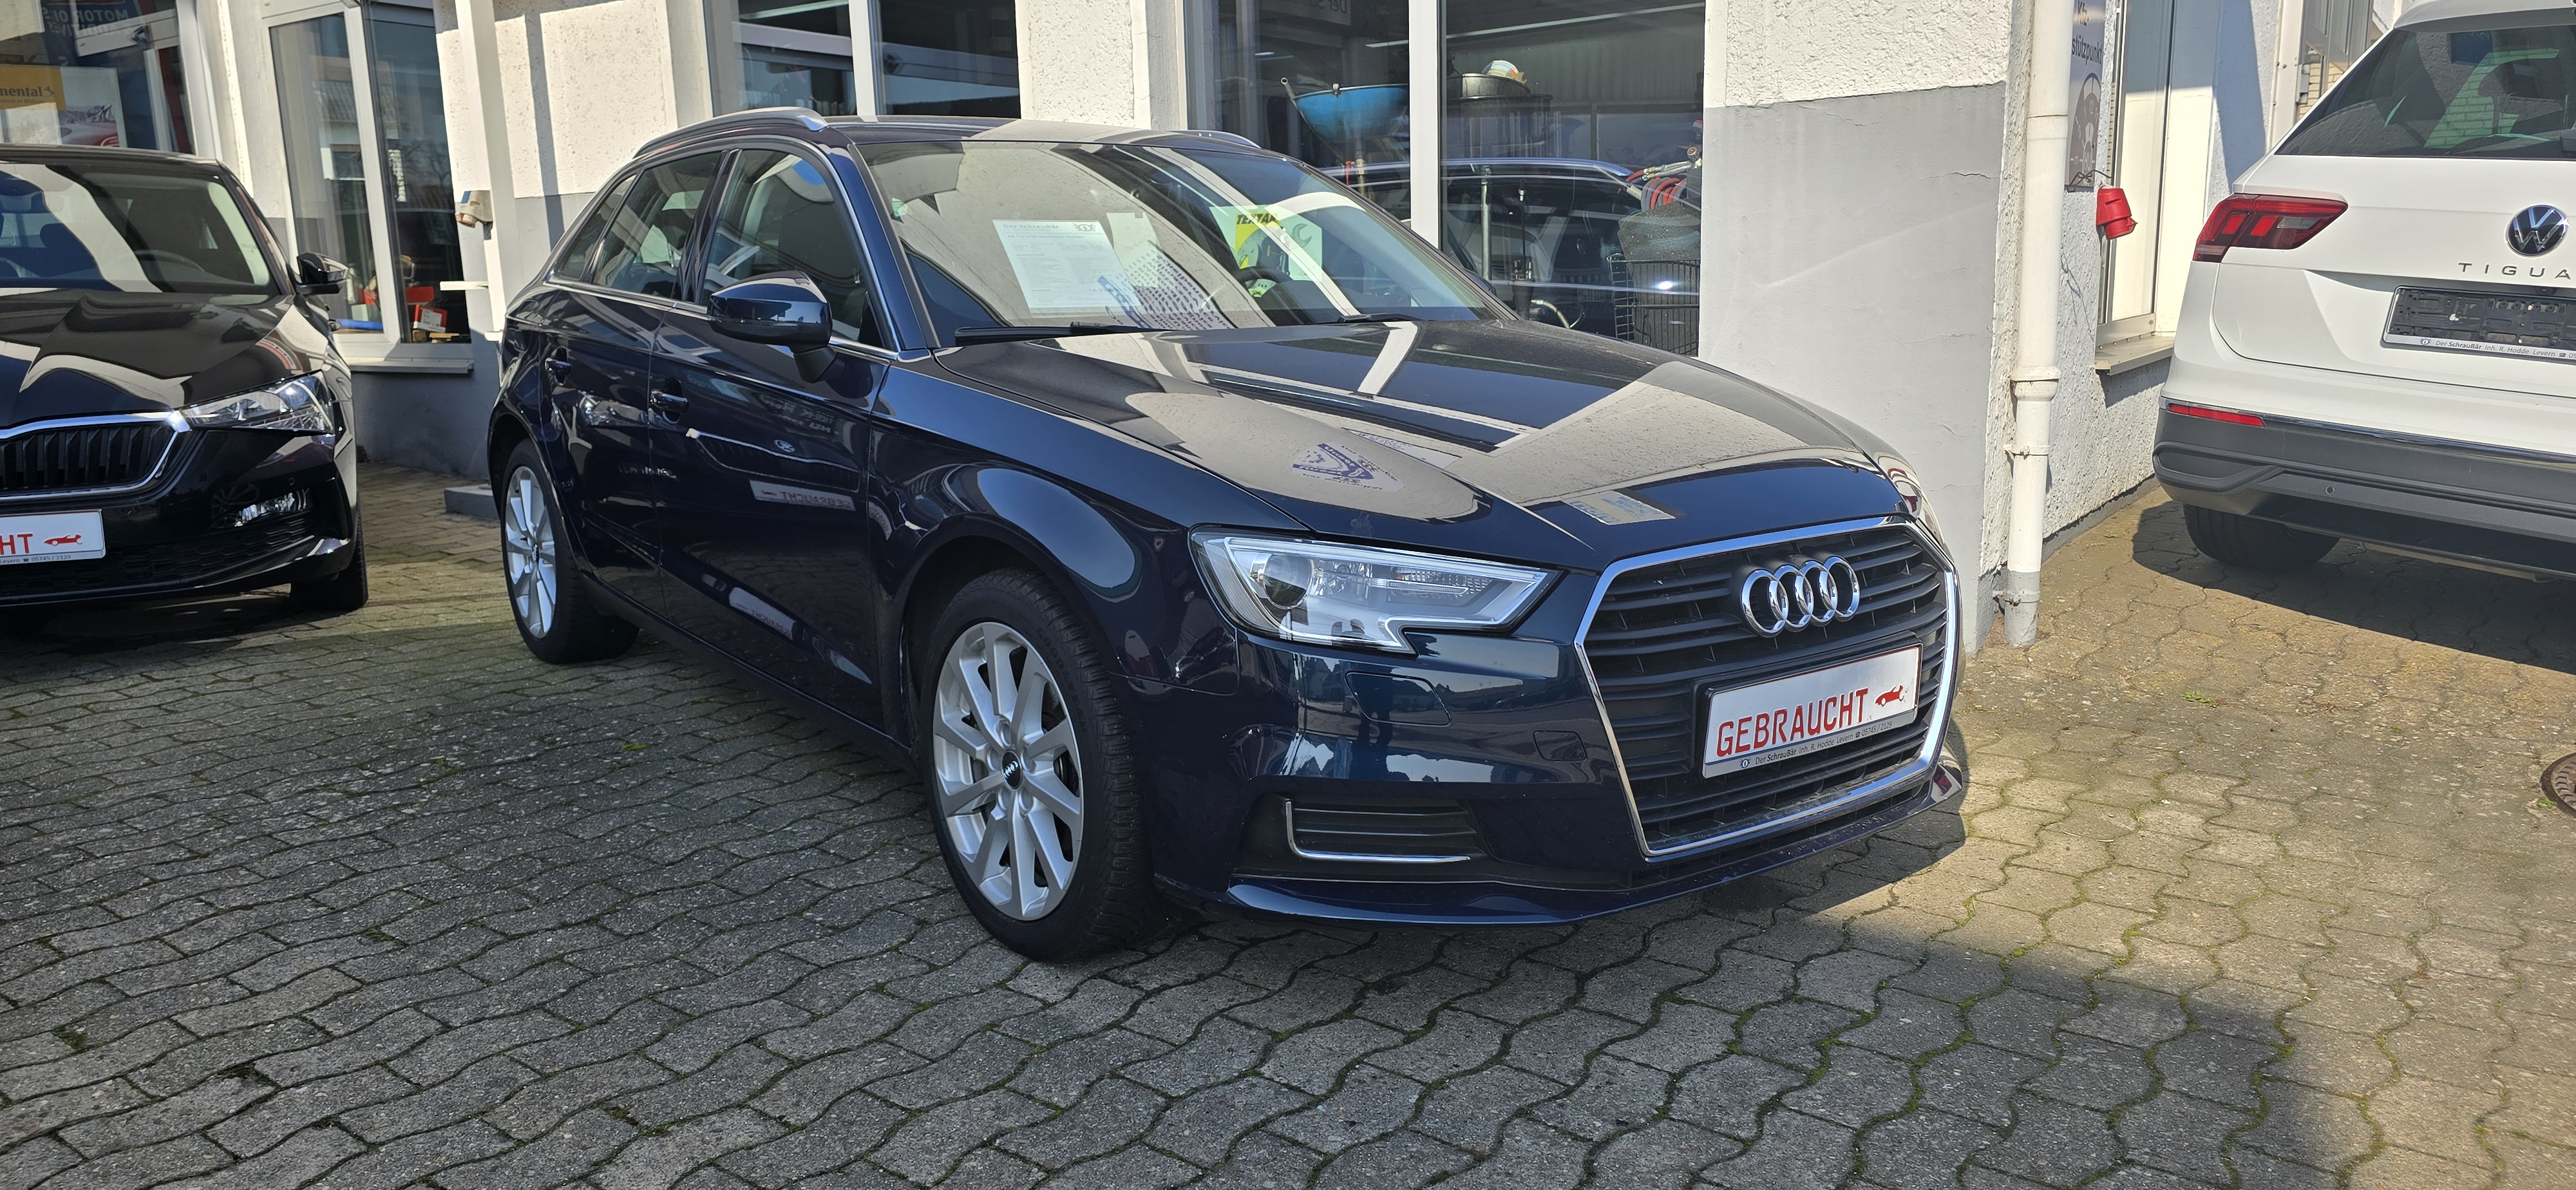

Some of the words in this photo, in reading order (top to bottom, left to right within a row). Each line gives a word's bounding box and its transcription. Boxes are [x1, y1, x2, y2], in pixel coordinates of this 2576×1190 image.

[2078, 0, 2089, 26] Kfz-
[2458, 262, 2571, 280] TIGUA
[2448, 341, 2482, 350] SchrauBär
[2507, 346, 2530, 355] Hodde
[0, 533, 33, 555] HT
[1716, 688, 1868, 757] GEBRAUCHT
[1755, 755, 1766, 765] Der
[1766, 748, 1797, 762] SchrauBär
[1799, 746, 1809, 754] Inh.
[1810, 742, 1816, 751] R.
[1817, 739, 1835, 749] Hodde
[1837, 734, 1853, 744] Levern
[1862, 727, 1877, 737] 05745
[1880, 721, 1892, 732] 2129
